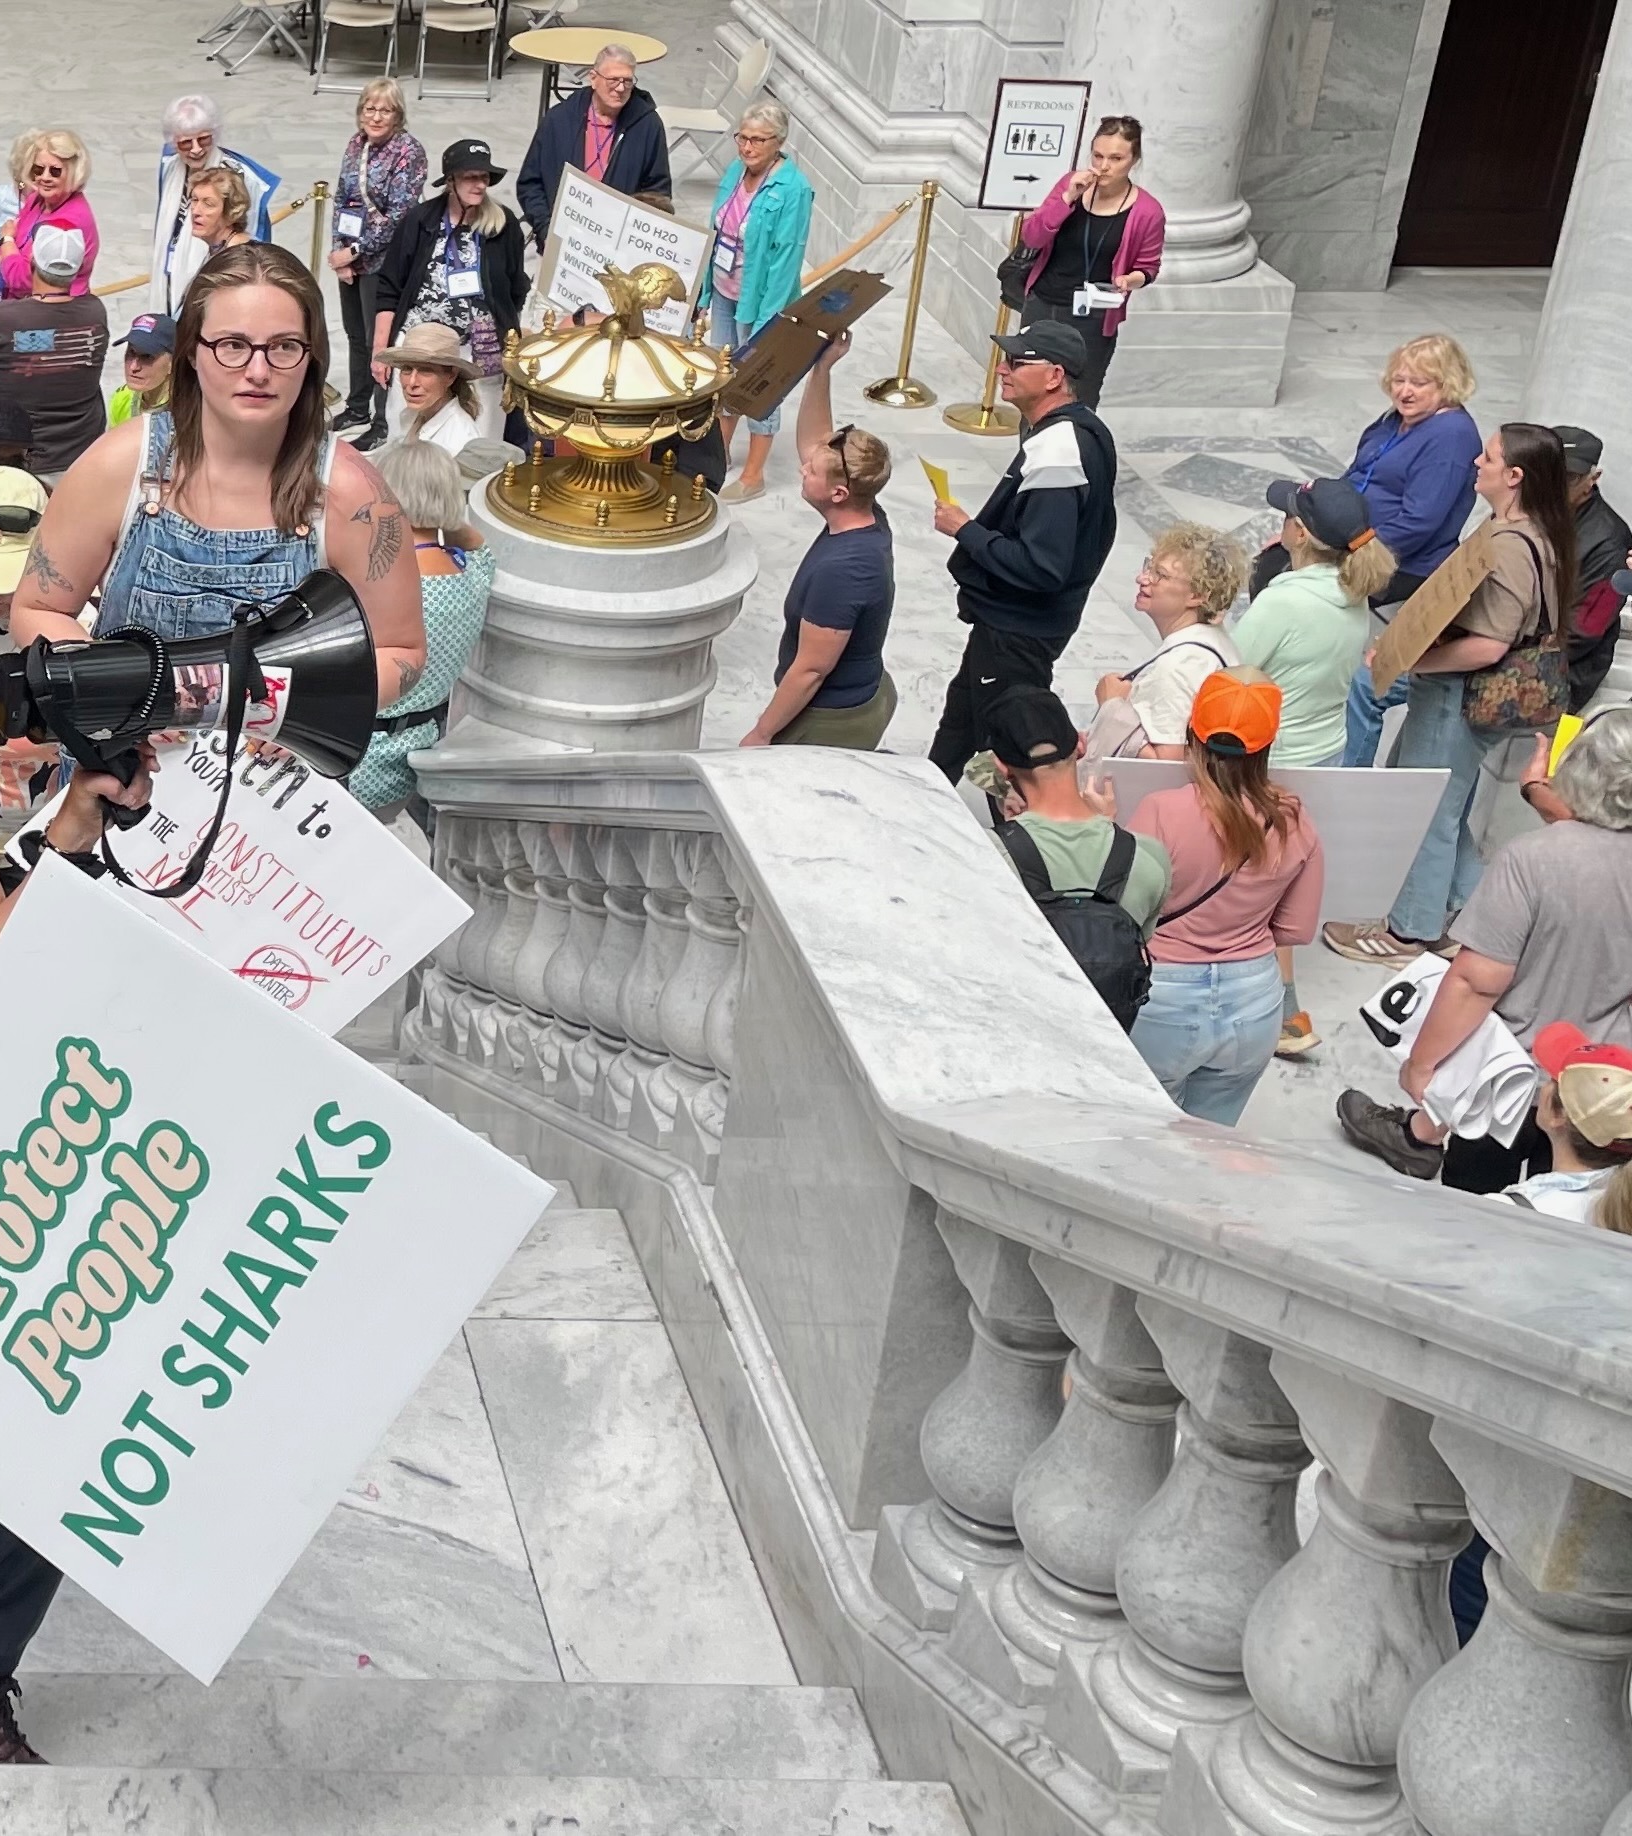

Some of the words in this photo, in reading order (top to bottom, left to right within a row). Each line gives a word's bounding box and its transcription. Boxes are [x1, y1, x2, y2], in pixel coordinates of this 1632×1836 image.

[1006, 99, 1075, 112] RESTROOMS
[568, 185, 593, 208] DATA
[563, 205, 604, 236] CENTER
[632, 218, 651, 234] NO
[652, 226, 679, 245] H2O
[567, 235, 582, 251] NO
[627, 234, 654, 254] FOR
[654, 246, 680, 265] GSL
[555, 282, 584, 307] TOXIC
[184, 741, 228, 793] YOUR
[149, 810, 180, 844] THE
[296, 799, 332, 839] to
[262, 951, 295, 982] DATA
[3, 1120, 210, 1415] People
[60, 1392, 196, 1567] NOT
[161, 1100, 392, 1411] SHARKS
